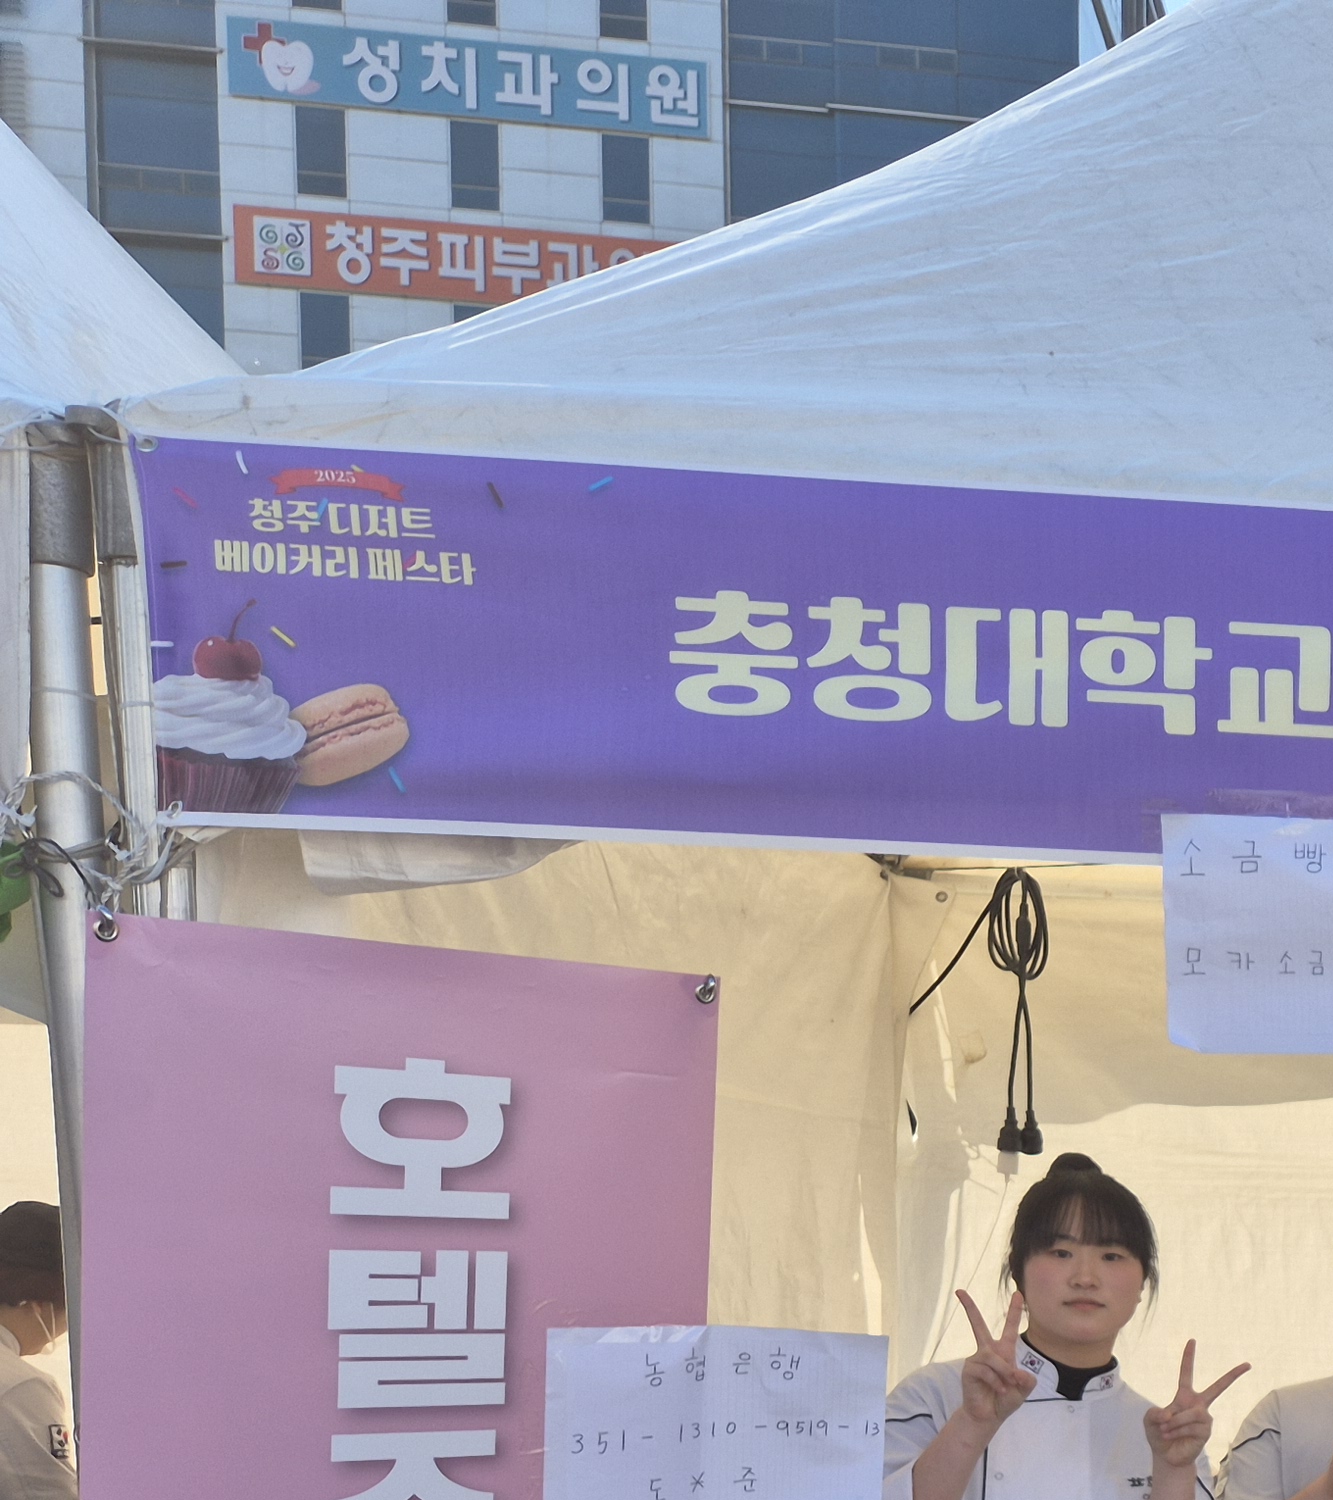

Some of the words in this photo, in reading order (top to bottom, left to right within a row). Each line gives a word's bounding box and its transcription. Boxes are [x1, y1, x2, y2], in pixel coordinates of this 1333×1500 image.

[343, 37, 701, 129] 성치과의원
[314, 469, 356, 485] 2025
[249, 498, 321, 534] 청주
[327, 502, 436, 538] 디저트
[214, 539, 359, 579] 베이커리
[365, 547, 477, 586] 페스타
[1180, 838, 1327, 877] 소금빵
